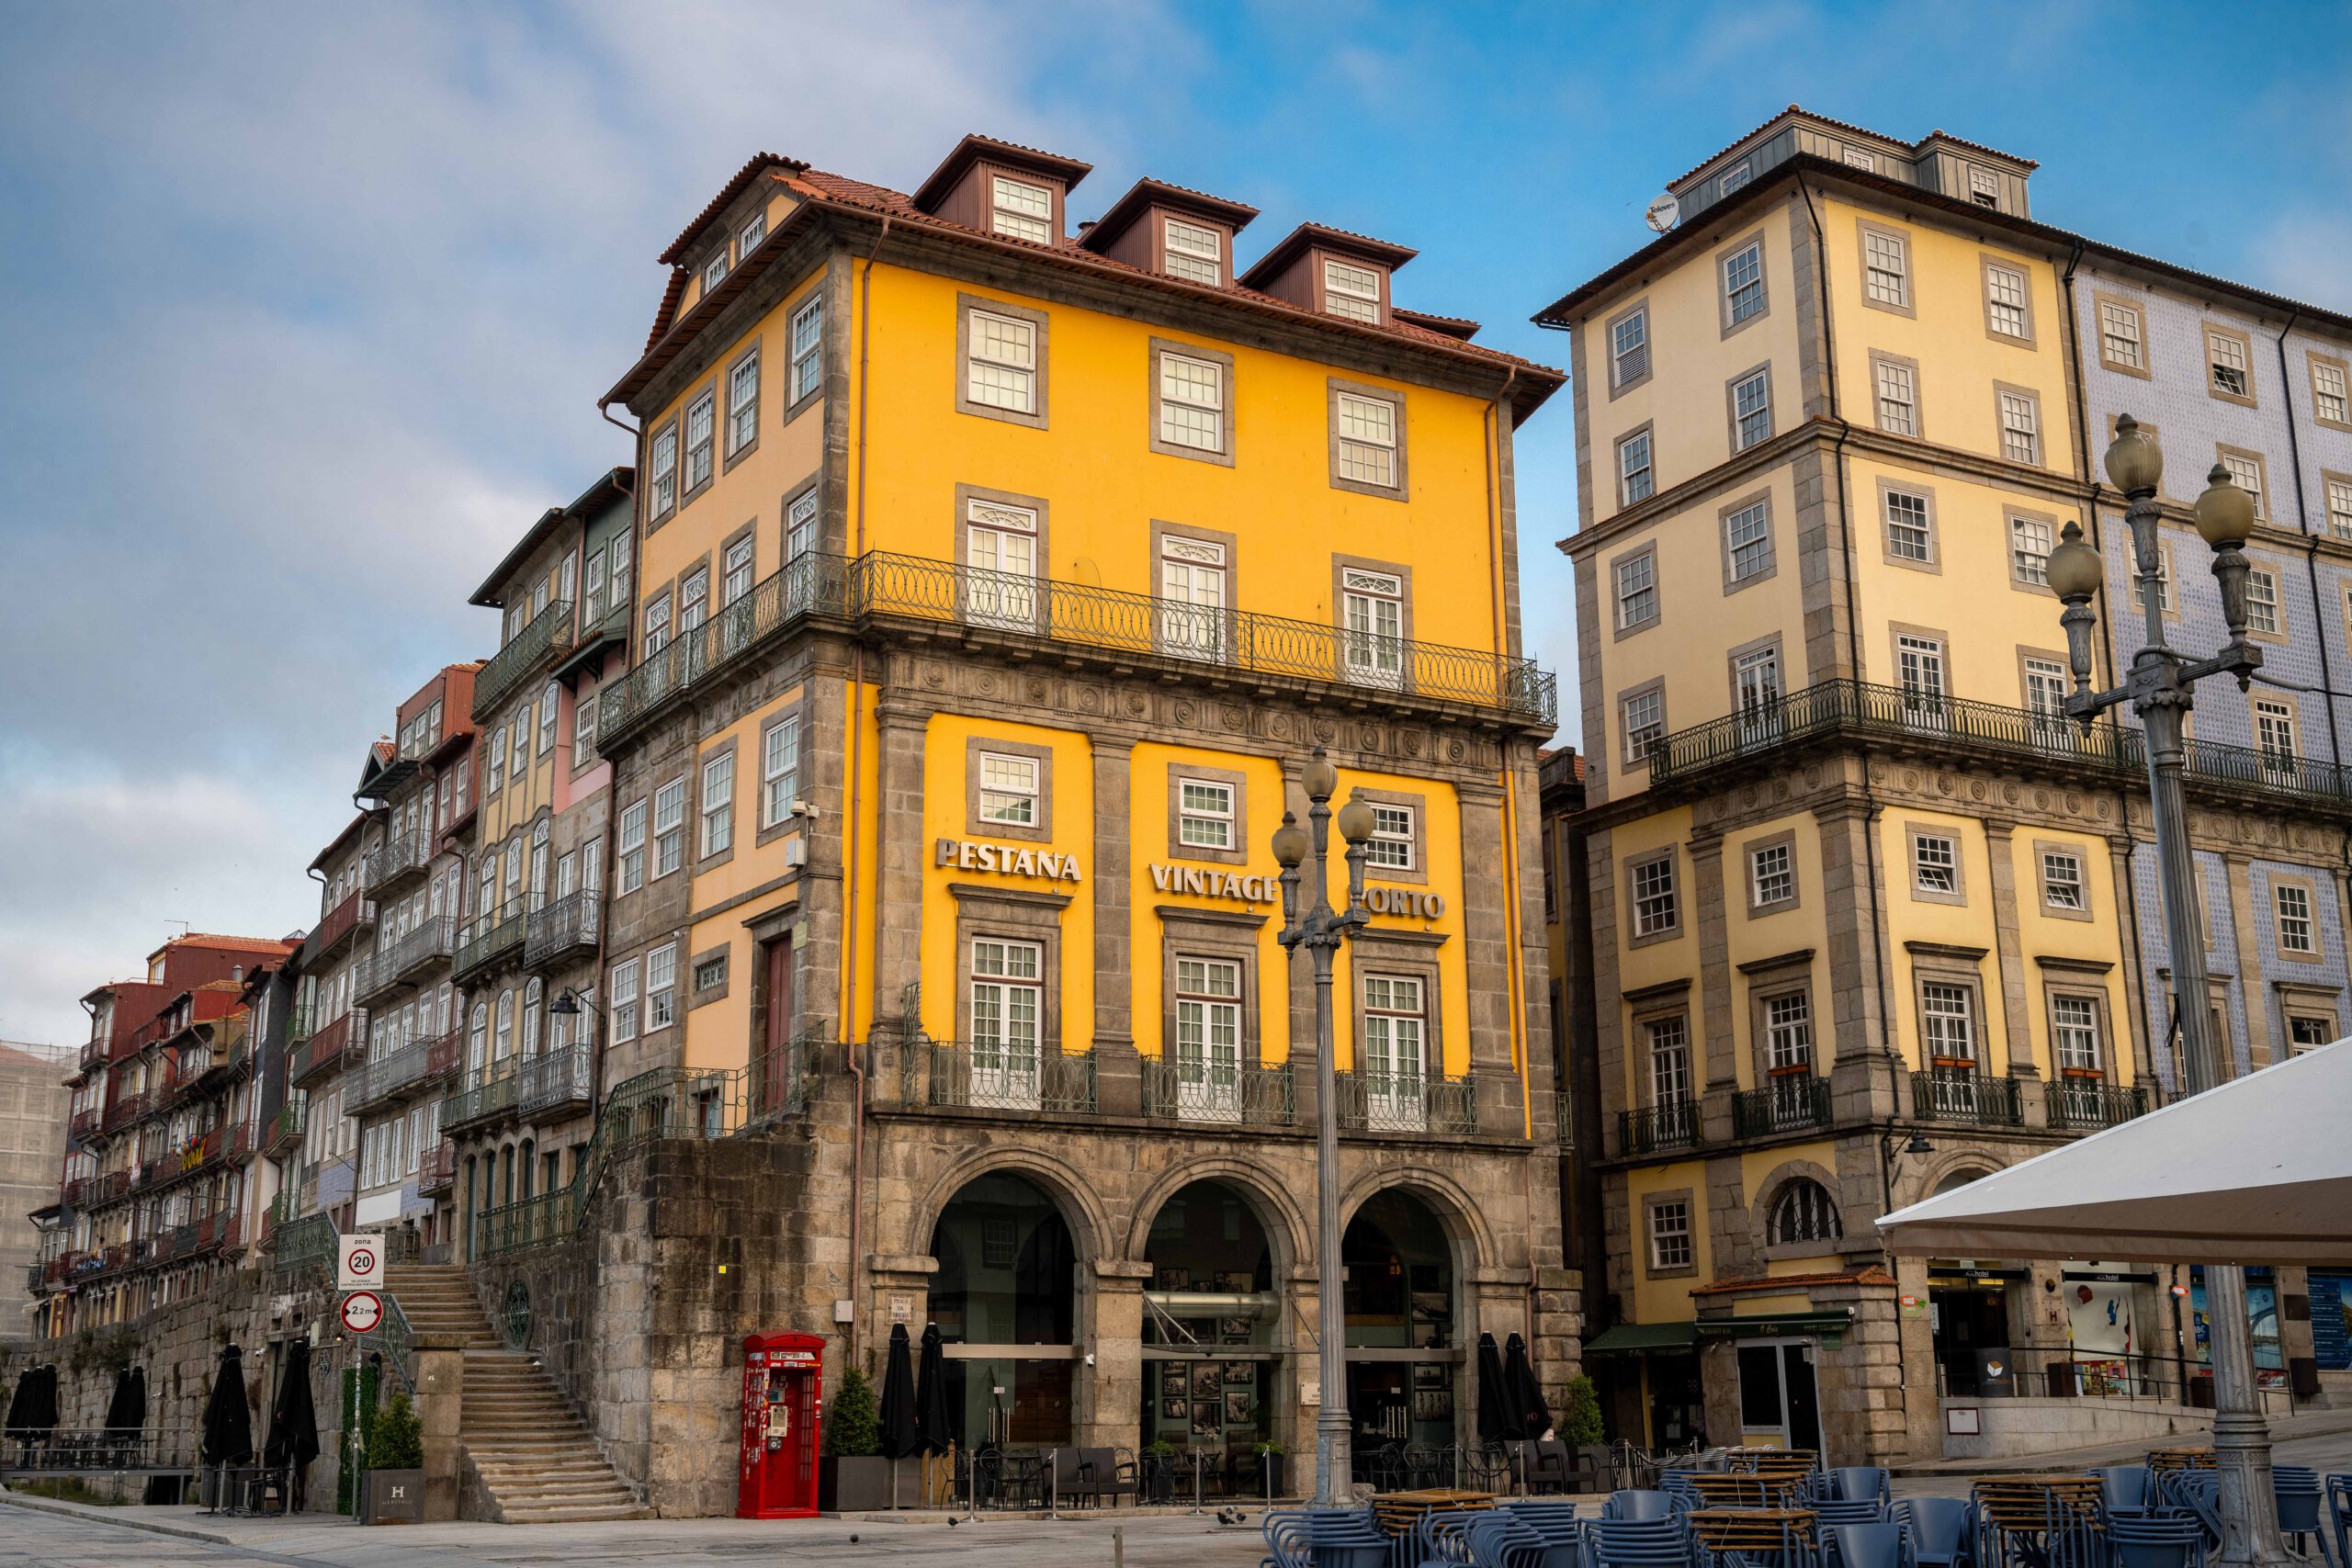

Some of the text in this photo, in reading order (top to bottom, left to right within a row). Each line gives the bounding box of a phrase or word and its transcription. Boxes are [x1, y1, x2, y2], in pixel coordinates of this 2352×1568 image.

[1649, 202, 1675, 213] Televes
[935, 838, 1082, 881] PESTANA
[1149, 863, 1278, 903] VINTAGE
[354, 1257, 370, 1268] 20
[390, 1486, 404, 1497] H
